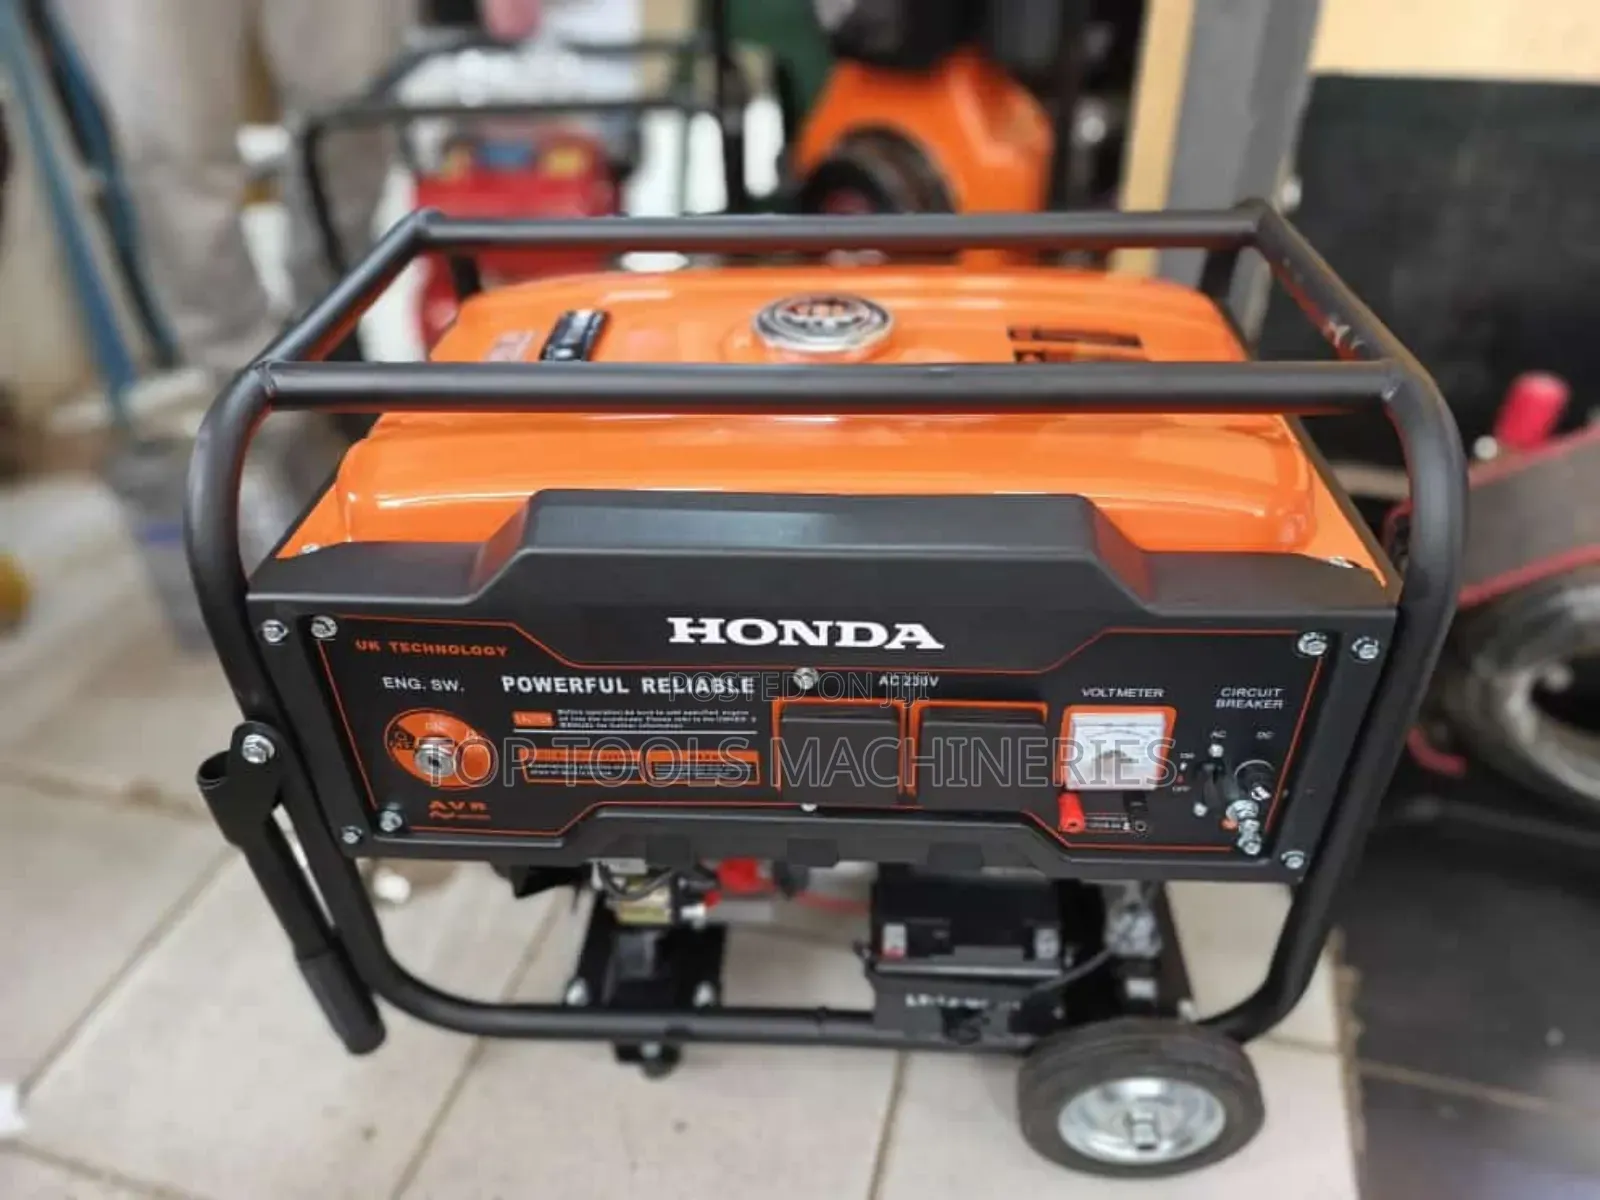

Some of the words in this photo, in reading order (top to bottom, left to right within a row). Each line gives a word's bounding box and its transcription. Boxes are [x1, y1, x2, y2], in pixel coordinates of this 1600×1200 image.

[667, 617, 945, 650] HONDA
[355, 639, 381, 651] UK
[388, 641, 509, 657] TECHNOLOGY
[382, 676, 427, 690] ENG.
[430, 678, 466, 692] SW.
[501, 675, 630, 694] POWERFUL
[641, 677, 756, 694] RELIABLE
[878, 675, 899, 687] AC
[1081, 687, 1166, 698] VOLTMETER
[1220, 687, 1284, 698] CIRCUIT
[1215, 699, 1285, 710] BREAKER
[428, 800, 488, 811] AVR
